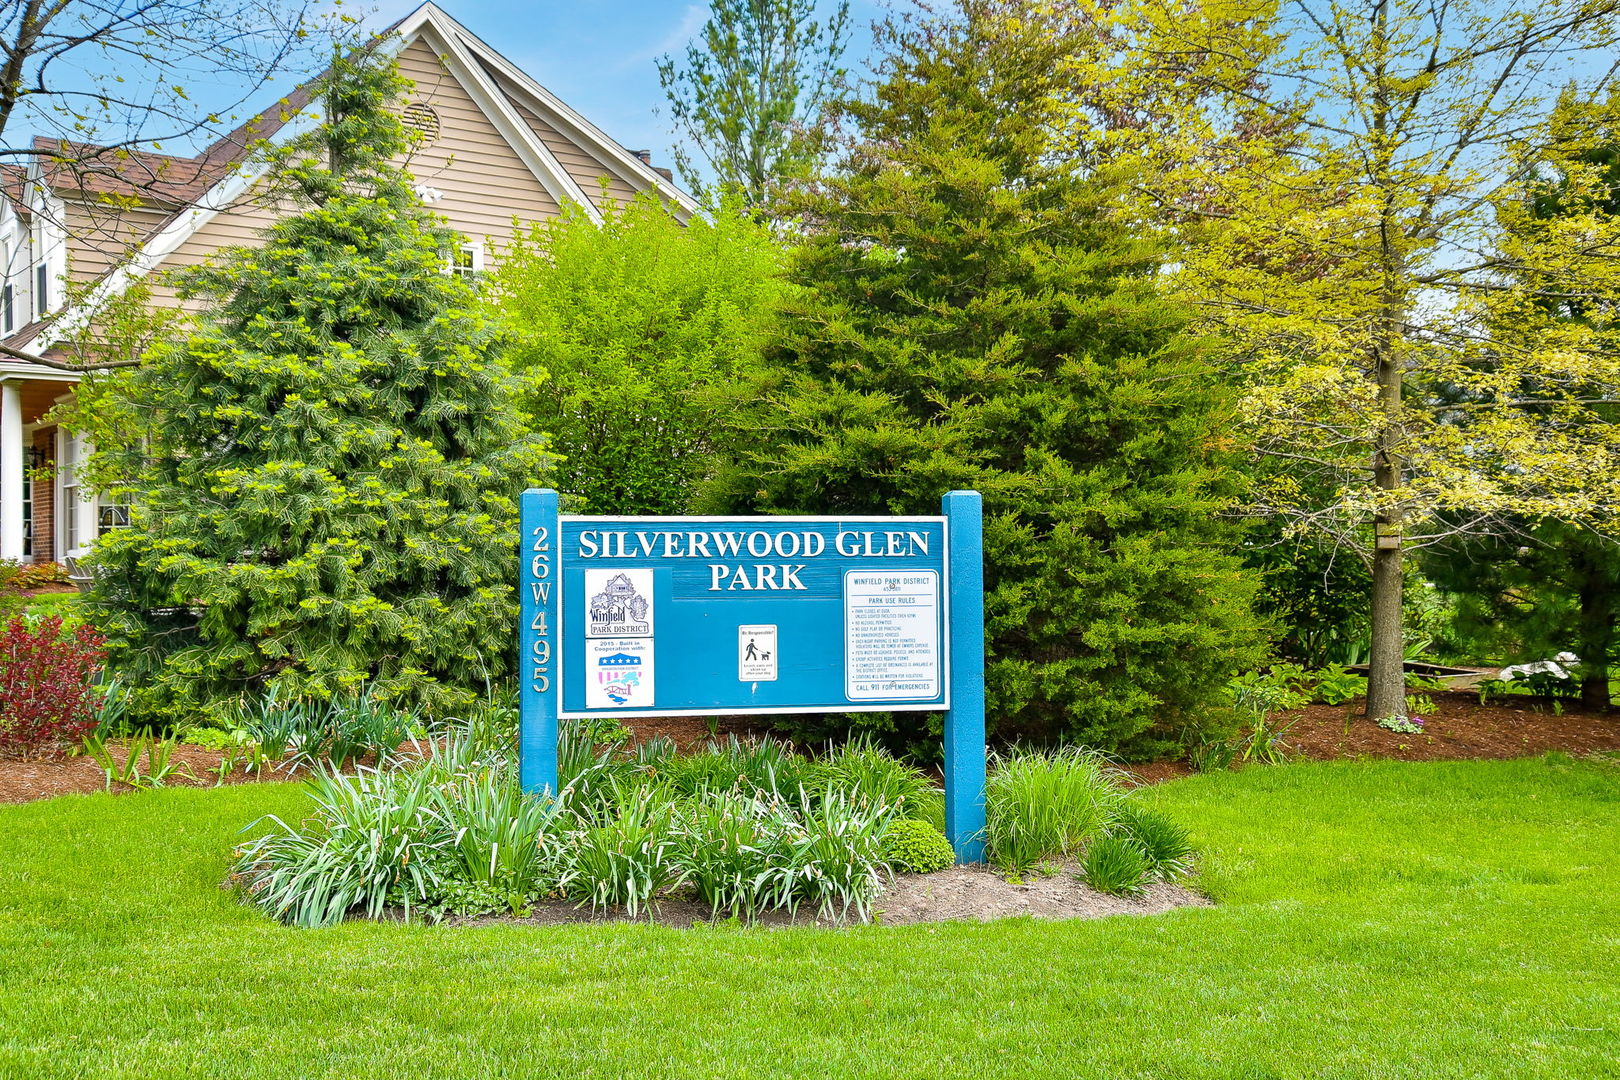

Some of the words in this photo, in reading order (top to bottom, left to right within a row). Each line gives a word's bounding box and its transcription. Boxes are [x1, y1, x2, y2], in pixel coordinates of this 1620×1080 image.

[579, 530, 825, 558] SILVERWOOD
[835, 531, 930, 557] GLEN
[708, 564, 808, 591] PARK
[590, 606, 625, 626] Winfield
